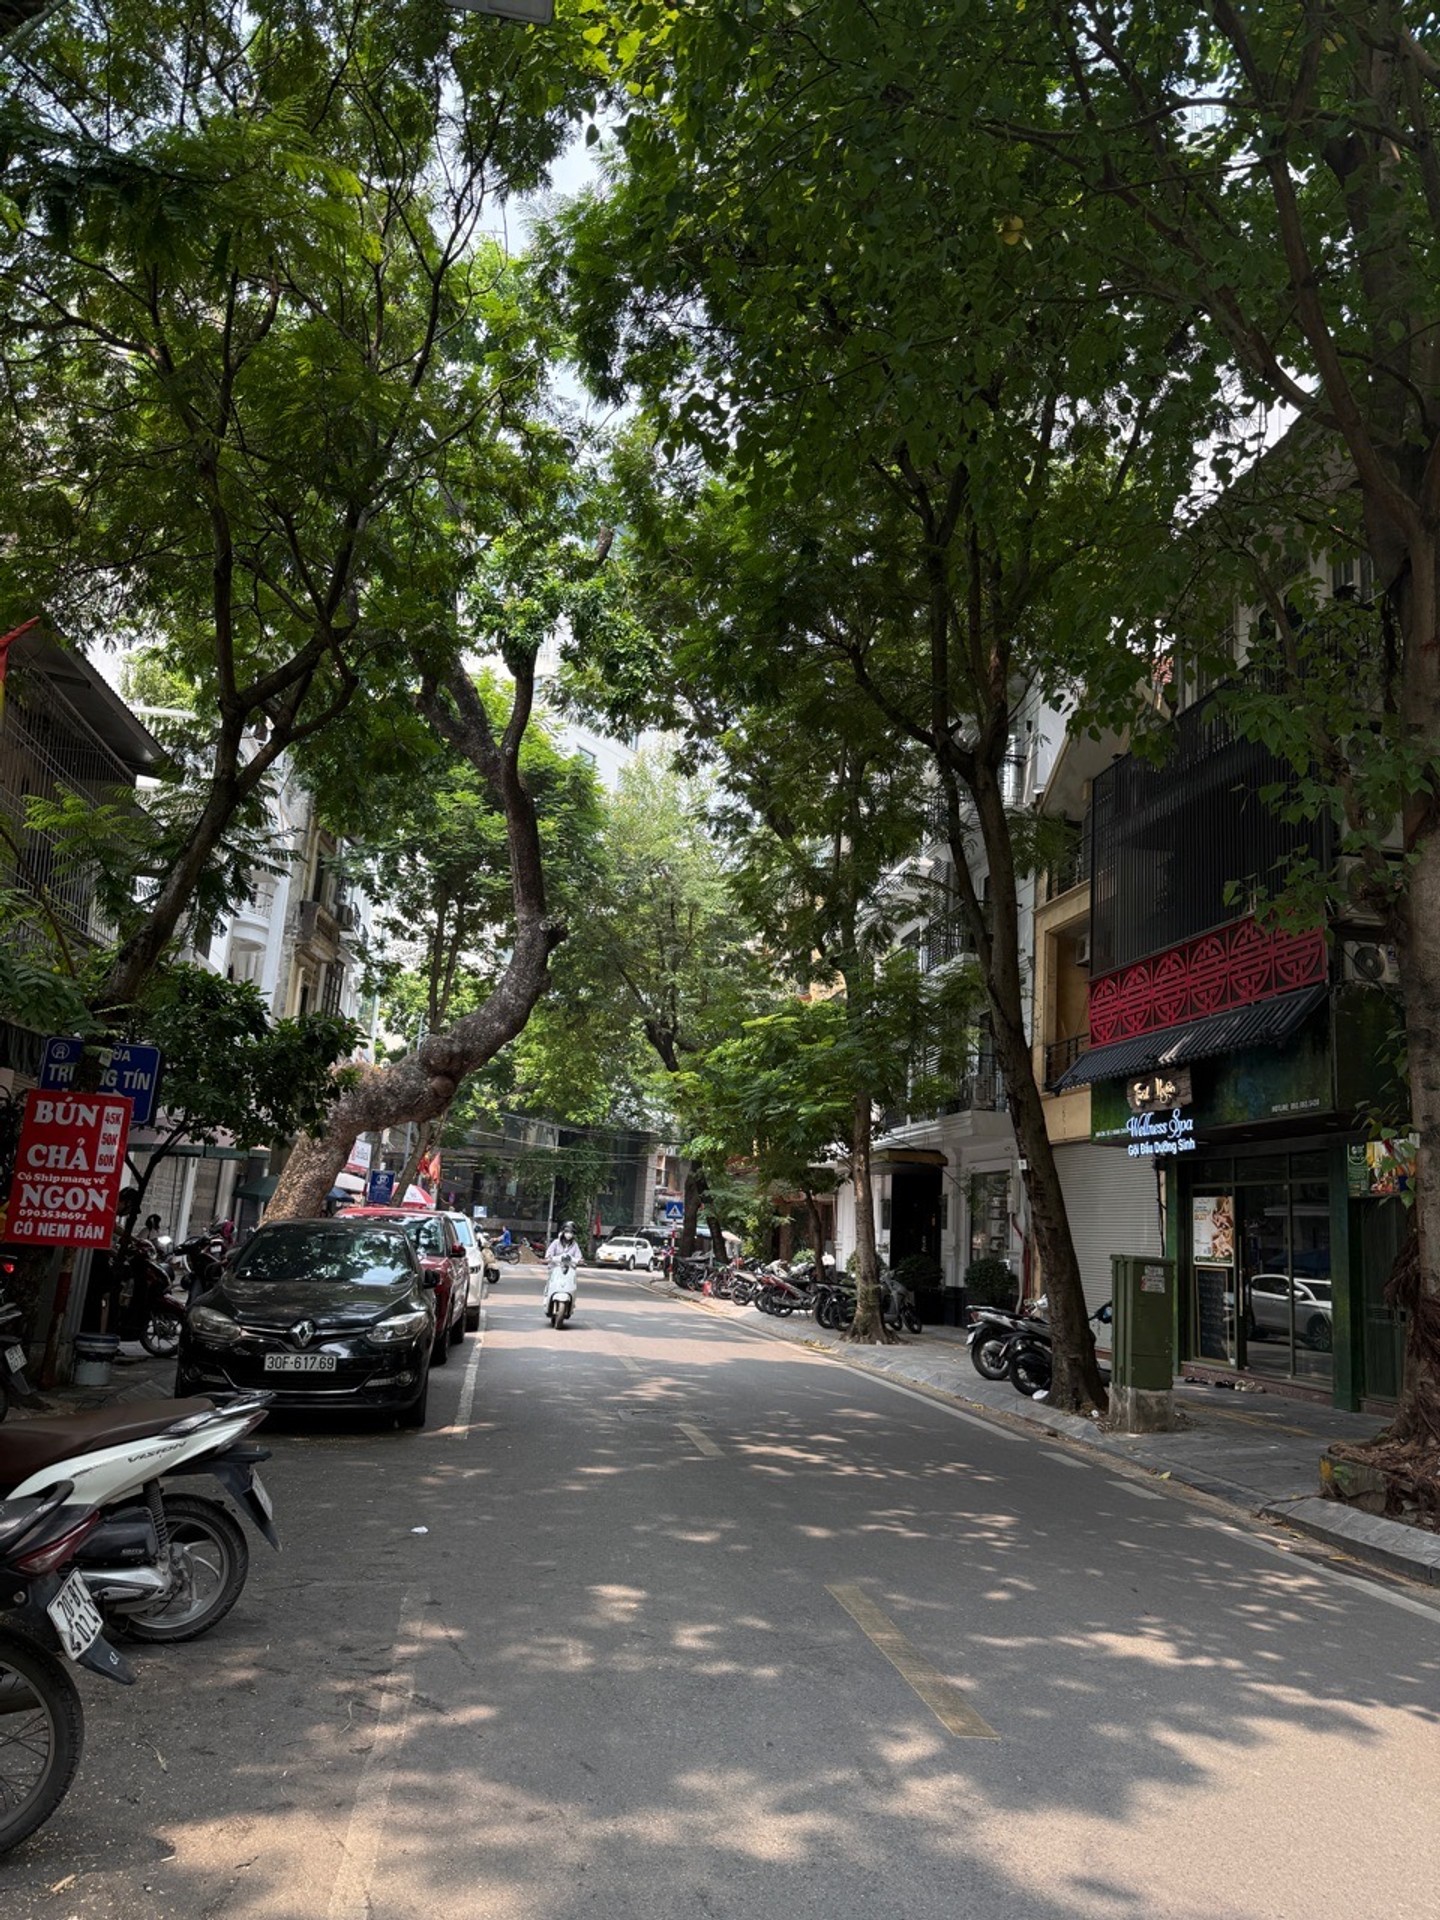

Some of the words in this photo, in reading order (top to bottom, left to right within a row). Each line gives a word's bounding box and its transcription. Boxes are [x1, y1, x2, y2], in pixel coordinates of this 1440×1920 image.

[123, 1068, 151, 1090] TÍN
[33, 1096, 100, 1128] BÚN
[1126, 1112, 1168, 1137] Wellness
[1168, 1108, 1194, 1139] Spa
[27, 1137, 89, 1171] CHẢ
[33, 1172, 60, 1184] Ship
[60, 1176, 92, 1186] mang
[19, 1184, 109, 1212] NGON
[13, 1218, 33, 1236] CÓ
[37, 1222, 70, 1238] NEM
[74, 1222, 105, 1240] RÁN
[266, 1355, 335, 1370] 30F-617.69
